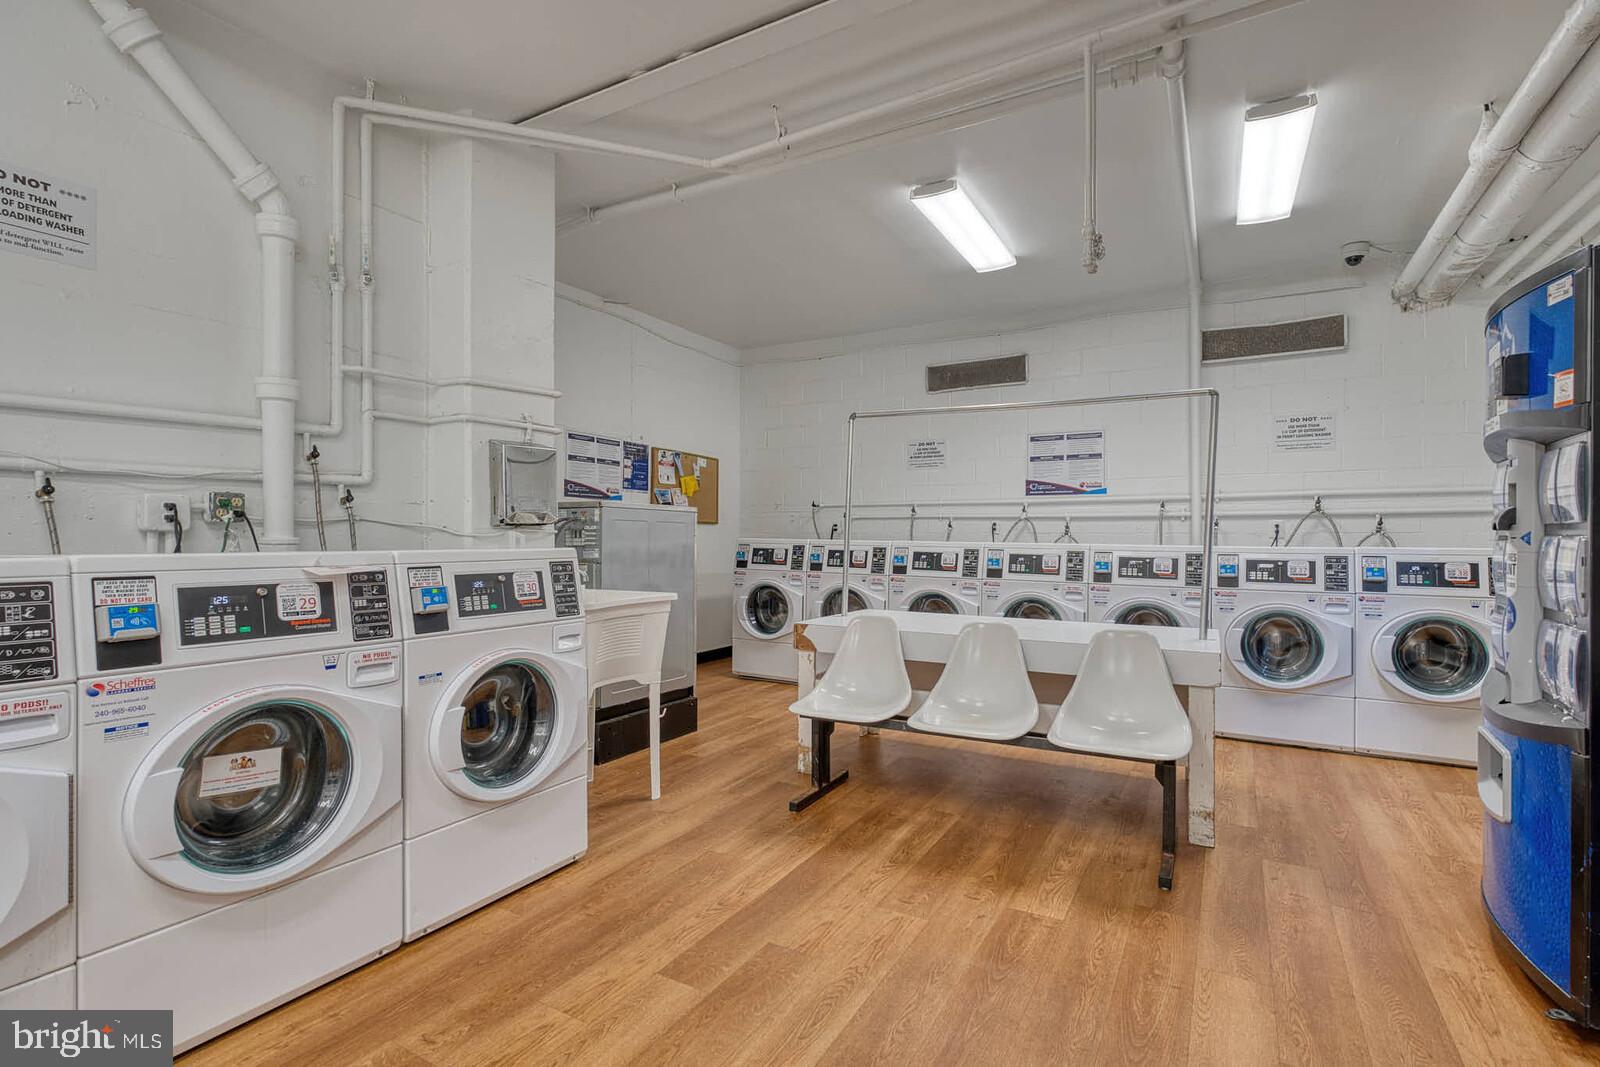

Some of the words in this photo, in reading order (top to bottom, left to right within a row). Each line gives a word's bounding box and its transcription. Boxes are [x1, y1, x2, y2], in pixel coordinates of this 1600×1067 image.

[13, 173, 51, 192] NOT
[27, 193, 57, 208] THAN
[1, 197, 14, 207] OF
[17, 201, 73, 223] DETERGENT
[0, 208, 43, 226] OADING
[45, 220, 85, 237] WASHER
[526, 583, 537, 592] 30
[299, 597, 317, 610] 29
[107, 677, 156, 691] Scheffres
[0, 704, 8, 712] O
